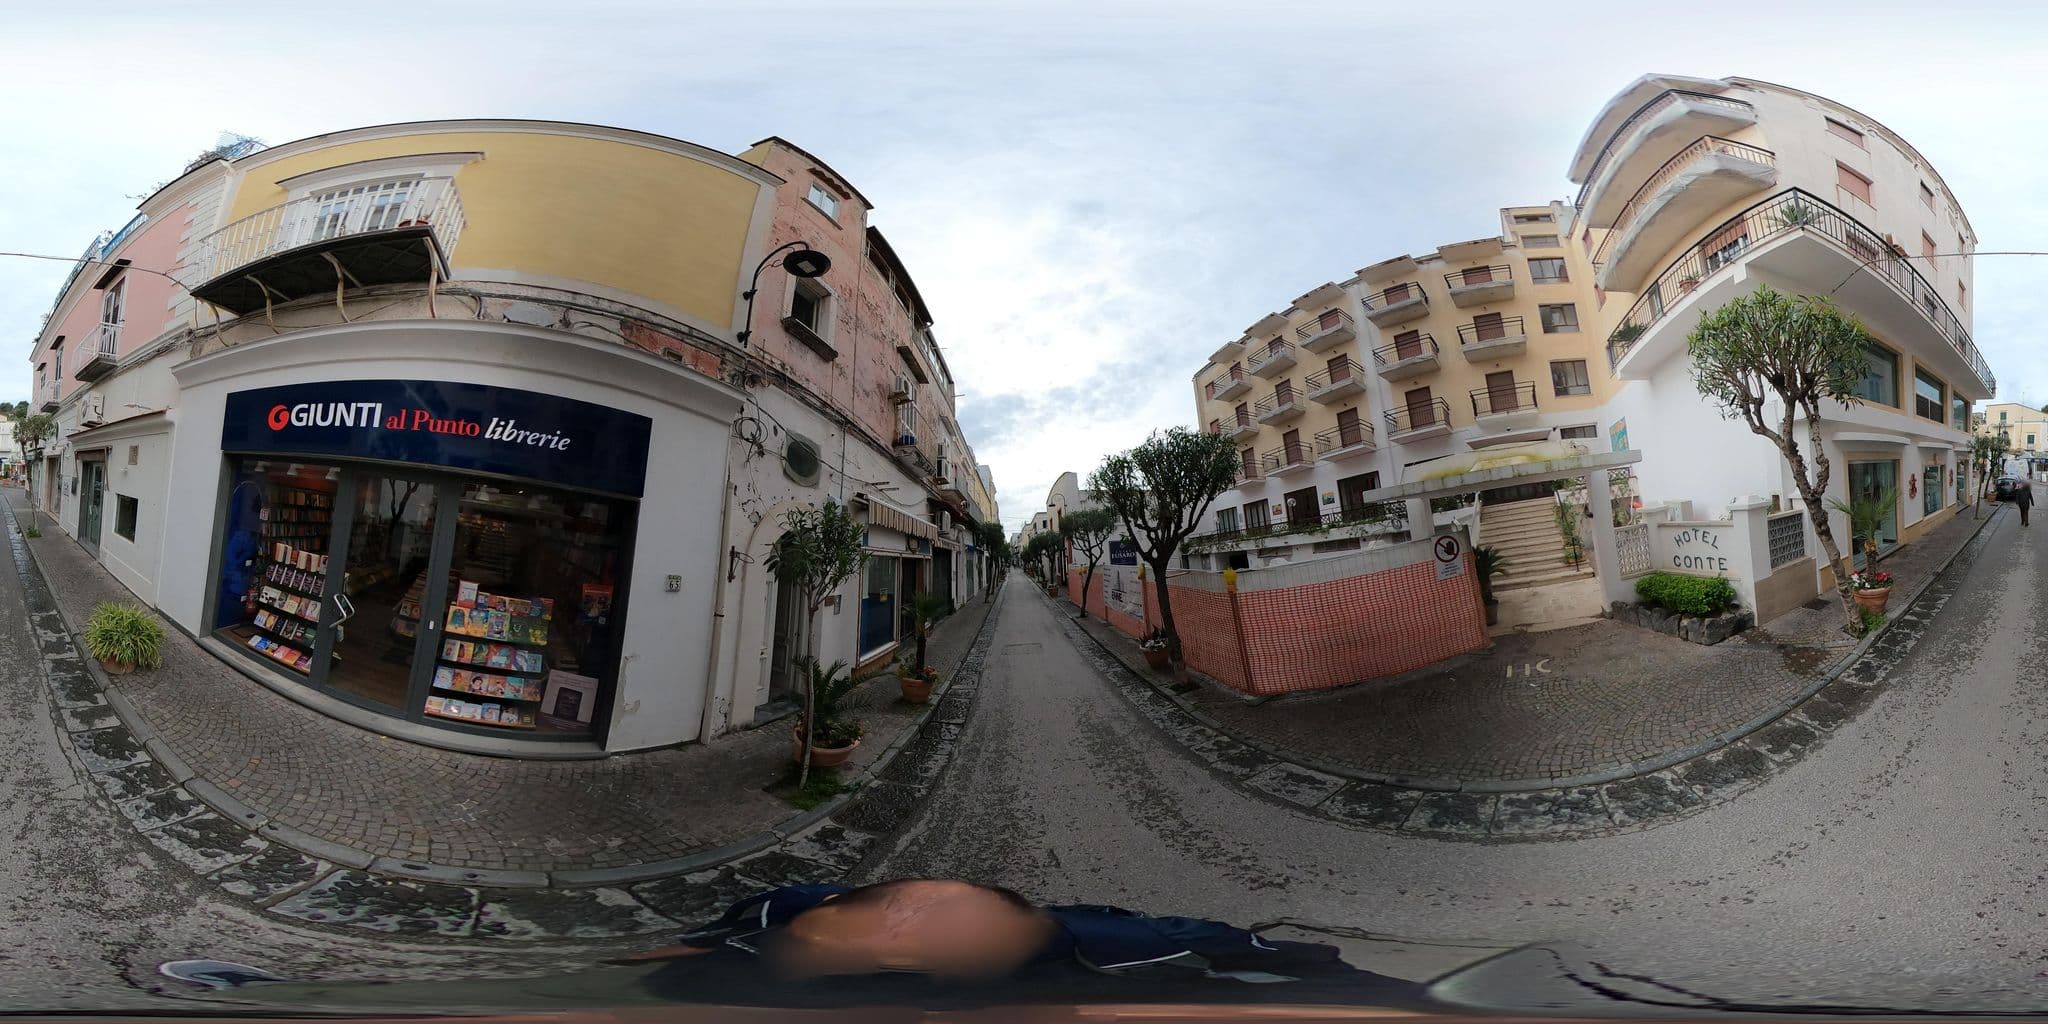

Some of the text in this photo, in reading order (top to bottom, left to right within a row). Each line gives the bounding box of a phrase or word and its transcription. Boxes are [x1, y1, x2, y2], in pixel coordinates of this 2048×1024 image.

[386, 409, 406, 430] al
[411, 409, 480, 437] Punto
[484, 417, 571, 451] librerie
[1674, 528, 1719, 549] HOTEL
